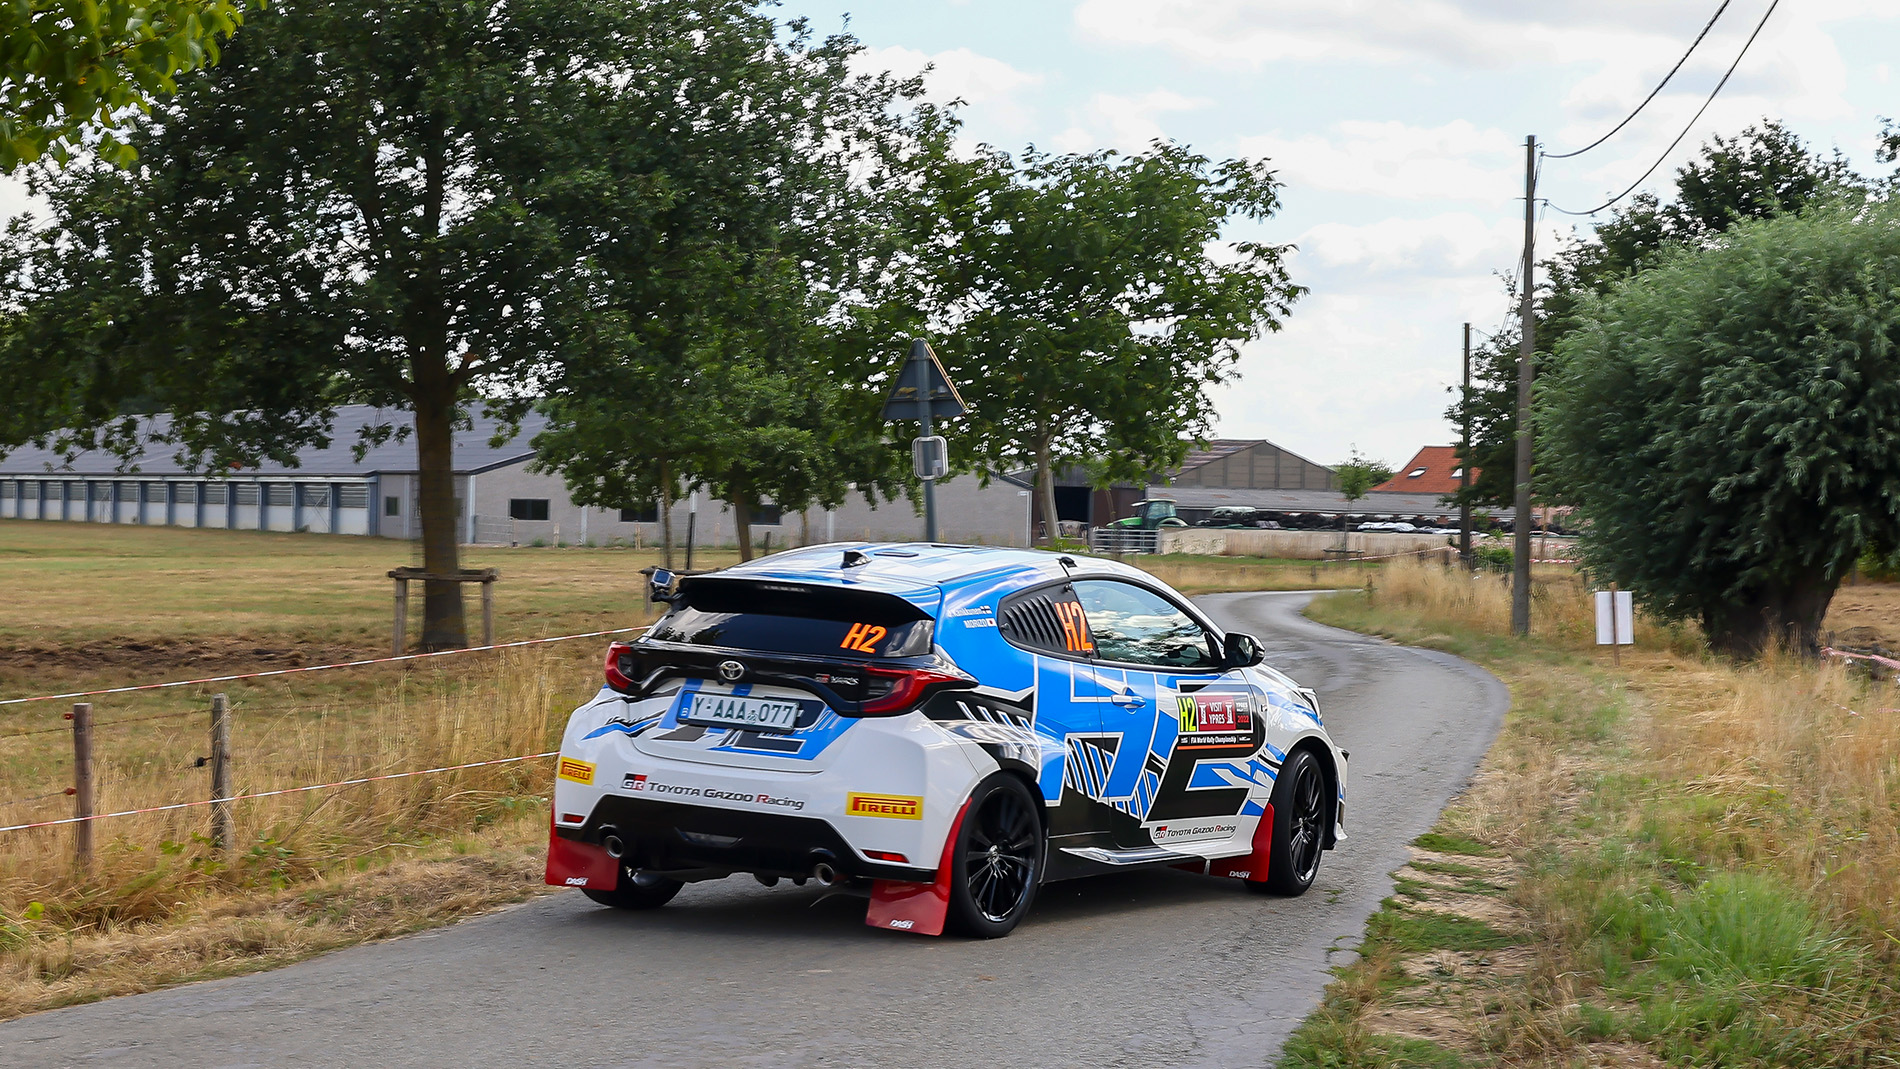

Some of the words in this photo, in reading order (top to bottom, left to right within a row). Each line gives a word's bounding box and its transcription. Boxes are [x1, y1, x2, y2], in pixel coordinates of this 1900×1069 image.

[1054, 601, 1094, 652] H2
[840, 622, 888, 654] H2
[1209, 702, 1223, 712] VISIT
[1177, 697, 1196, 732] H2
[1209, 714, 1225, 724] YPRES
[1237, 715, 1250, 723] 2022
[561, 761, 592, 781] PIRELLI
[621, 776, 647, 790] GR
[648, 782, 700, 797] TOYOTA
[703, 788, 754, 802] GAZOO
[755, 794, 805, 811] Racing
[852, 796, 917, 815] PIRELLI
[1167, 828, 1191, 837] TOYOTA
[1192, 826, 1214, 835] GAZOO
[1214, 824, 1237, 833] Racing
[1228, 870, 1251, 879] DASH
[564, 877, 589, 886] DASH
[889, 919, 915, 929] DASH
